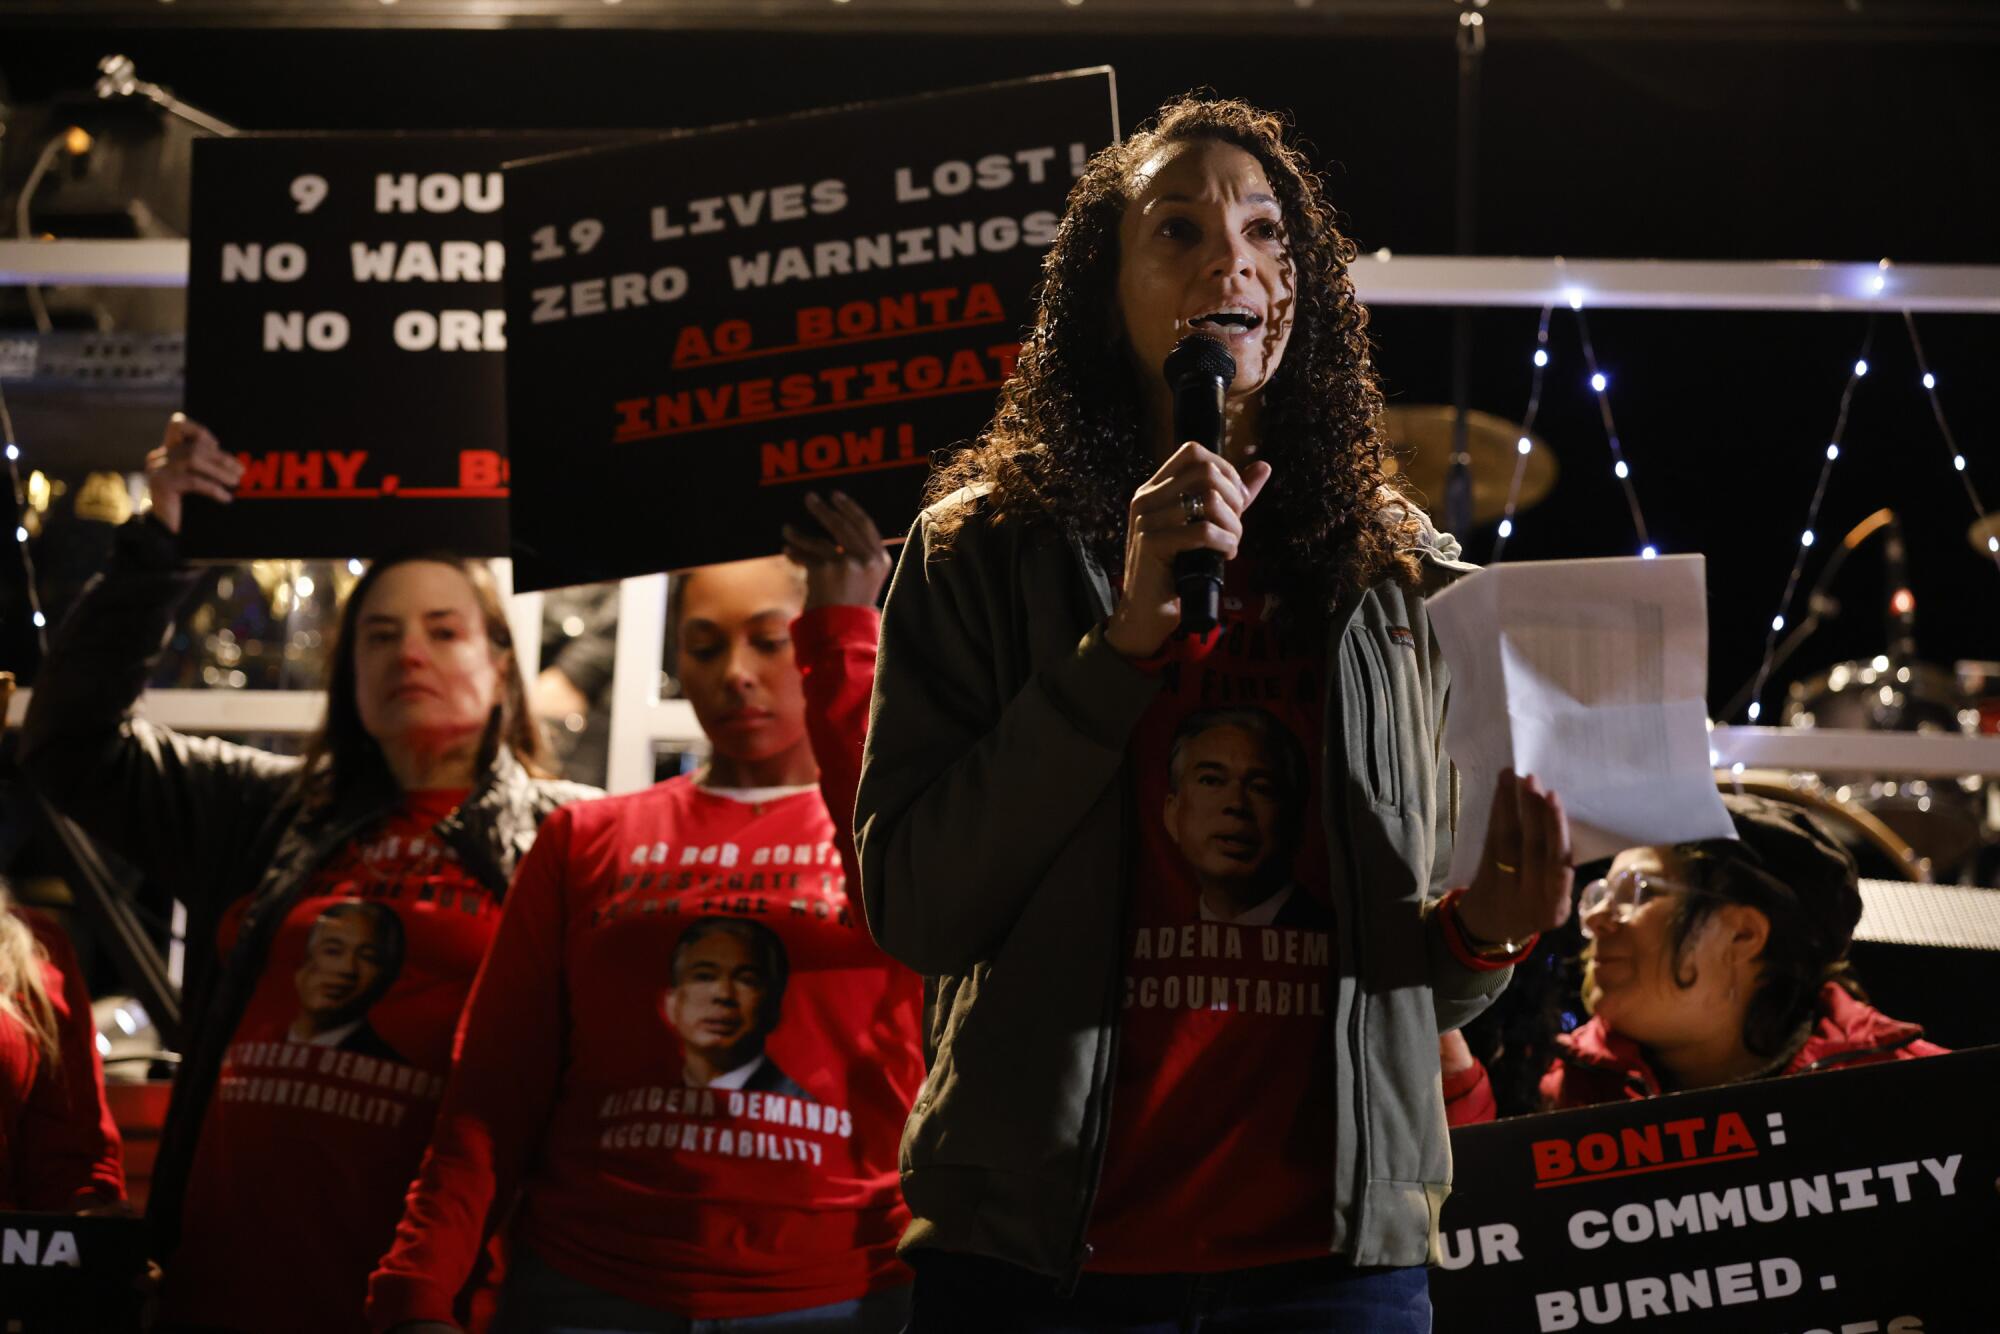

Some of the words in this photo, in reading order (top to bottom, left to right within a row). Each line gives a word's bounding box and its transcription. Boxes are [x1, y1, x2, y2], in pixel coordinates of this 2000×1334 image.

[289, 173, 329, 213] 9
[530, 218, 604, 262] 19
[650, 177, 849, 241] LIVES
[894, 142, 1088, 204] LOST!
[220, 241, 308, 282] NO
[530, 266, 690, 324] ZERO
[728, 210, 1058, 290] WARNINGS
[262, 310, 352, 352] NO
[672, 319, 753, 366] AG
[795, 281, 1006, 346] BONTA
[458, 448, 512, 492] B
[759, 423, 917, 480] NOW!
[1128, 924, 1243, 960] ADENA
[1261, 927, 1329, 967] DEM
[727, 1090, 854, 1139] DEMANDS
[599, 1120, 823, 1167] ACCOUNTABILITY
[1531, 1111, 1787, 1185] BONTA:
[1567, 1153, 1963, 1252] COMMUNITY
[1, 1227, 81, 1268] NA
[1534, 1256, 1838, 1334] BURNED.
